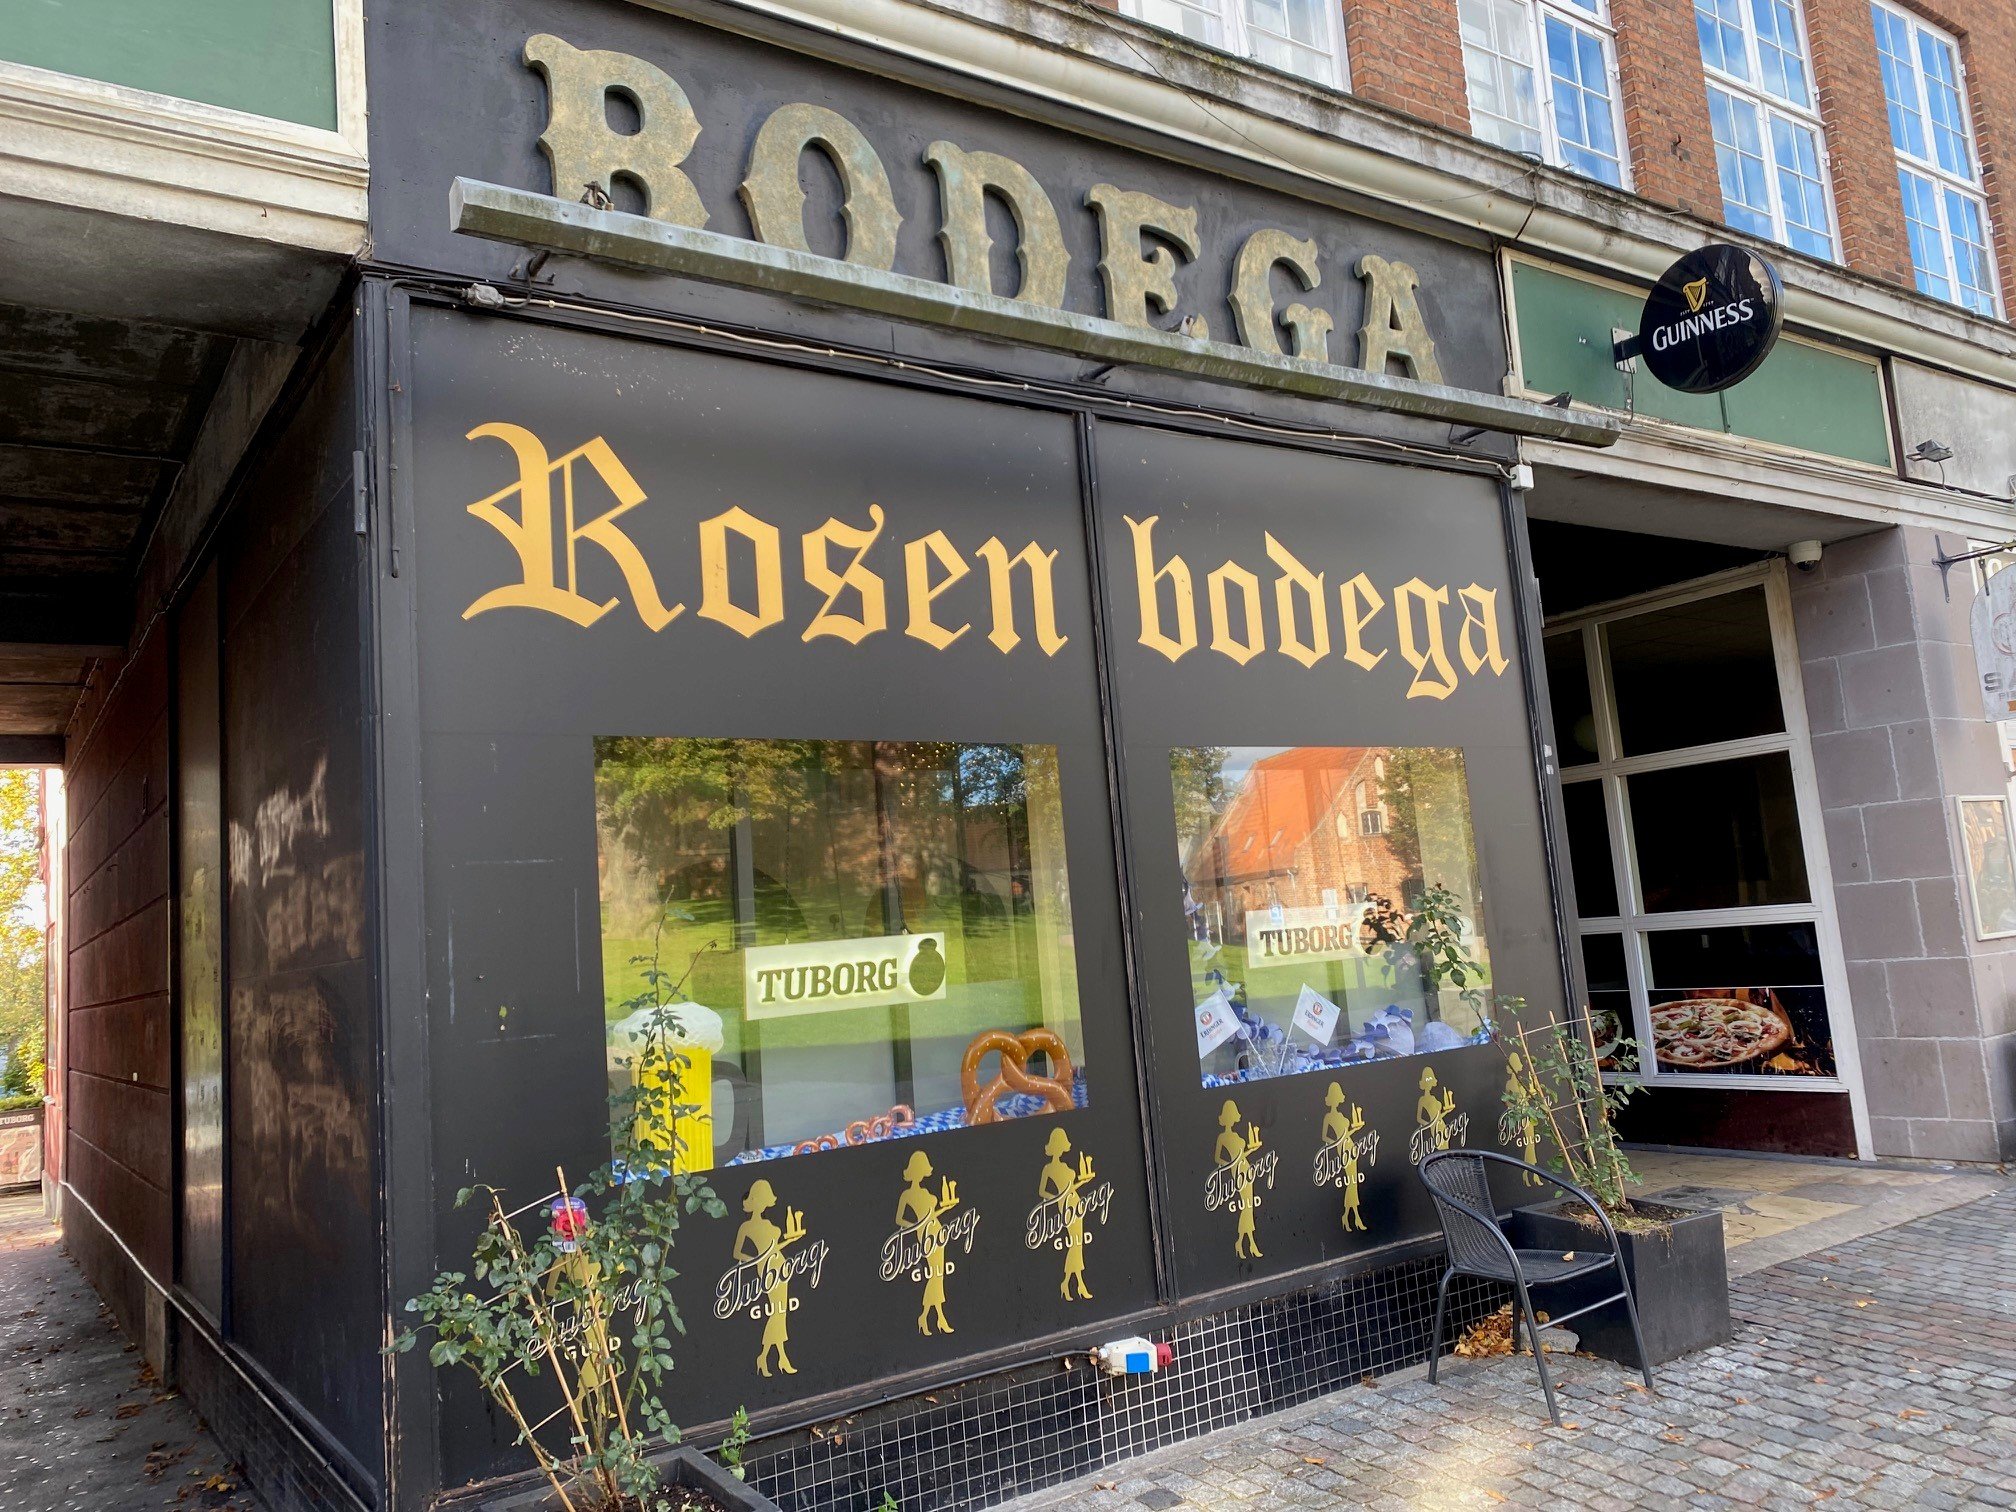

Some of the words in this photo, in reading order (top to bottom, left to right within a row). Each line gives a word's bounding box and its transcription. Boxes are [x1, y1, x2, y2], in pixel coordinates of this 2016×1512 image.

[522, 33, 1444, 385] BODEGA
[1652, 298, 1754, 351] GUINNESS
[461, 422, 1069, 657] Rosen
[1122, 514, 1510, 700] bodega
[1260, 923, 1353, 957] TUBORG
[757, 958, 898, 1003] TUBORG
[1313, 1129, 1379, 1187] Tuborg
[1409, 1110, 1470, 1166] Tuborg
[1516, 1133, 1541, 1148] GULD
[1204, 1149, 1279, 1212] Tuborg
[1228, 1195, 1262, 1213] GULD
[1334, 1172, 1366, 1188] GULD
[1025, 1181, 1115, 1250] Tuborg
[879, 1206, 981, 1282] Tuborg
[1053, 1230, 1093, 1251] GULD
[712, 1238, 830, 1320] Tuborg
[911, 1261, 956, 1283] GULD
[749, 1297, 801, 1320] GULD
[564, 1336, 621, 1361] GUD
